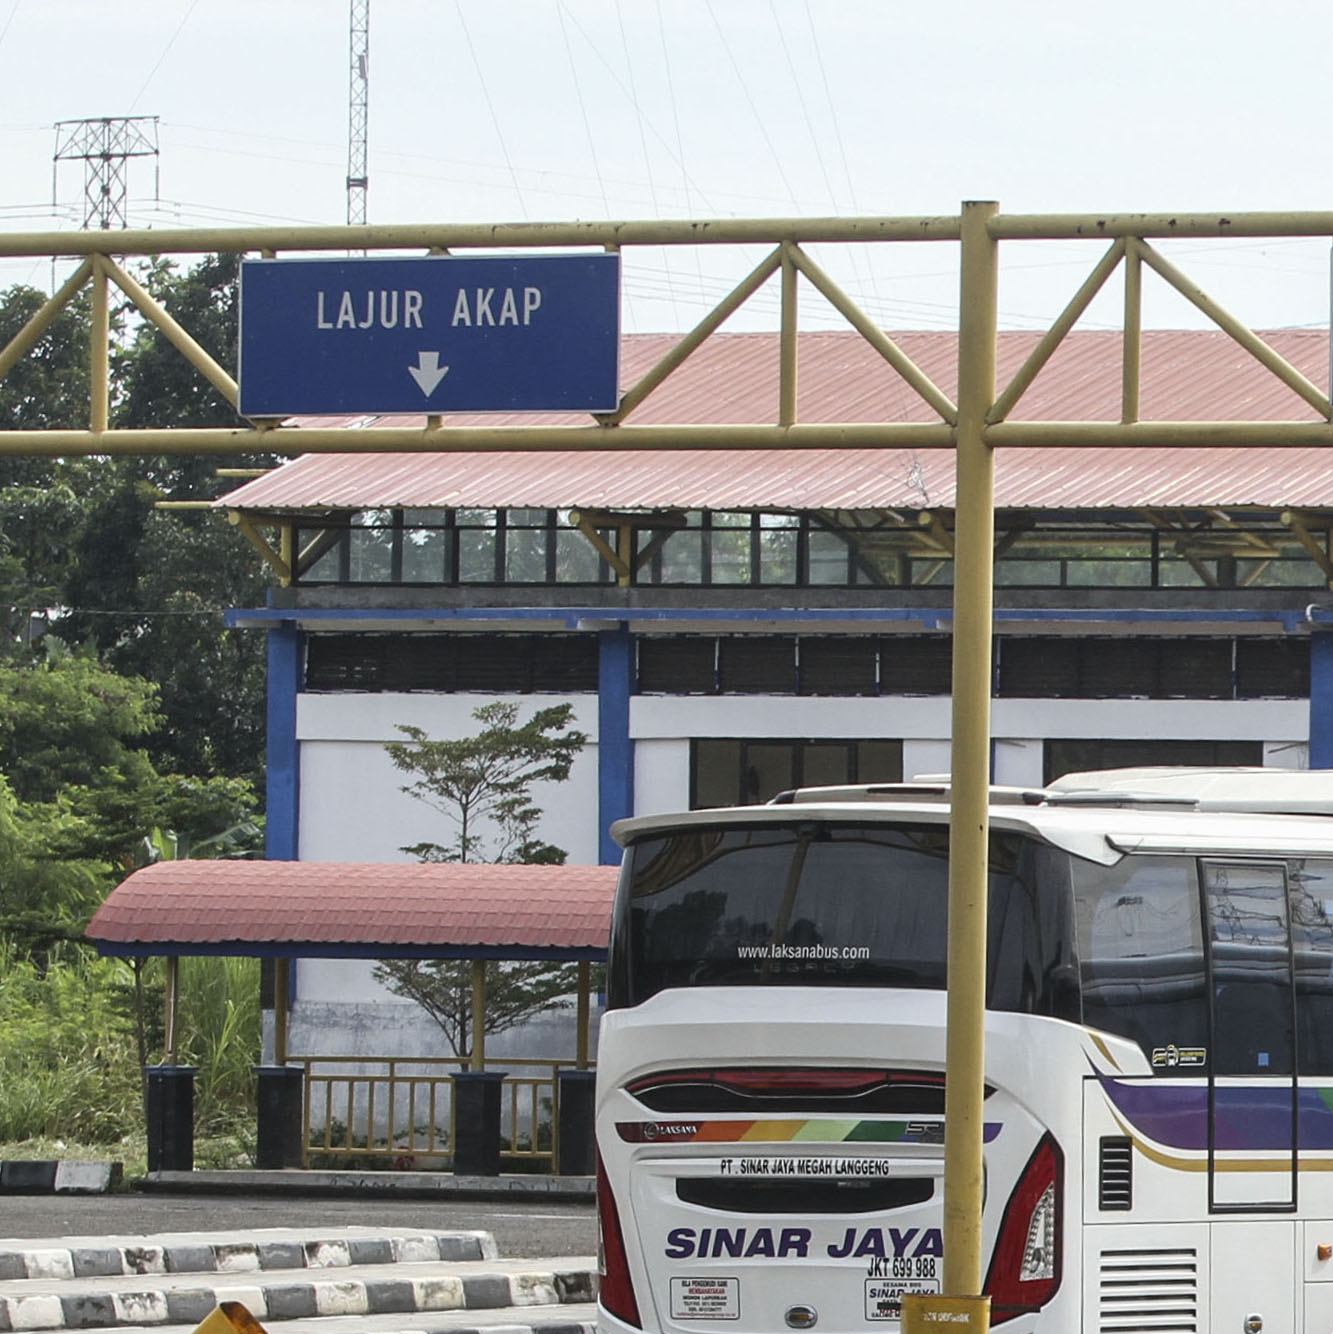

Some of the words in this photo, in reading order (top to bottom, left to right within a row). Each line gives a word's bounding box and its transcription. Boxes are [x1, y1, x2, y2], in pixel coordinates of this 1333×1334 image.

[317, 290, 423, 329] LAJUR
[451, 287, 542, 326] AKAP
[737, 943, 870, 960] www.laksanabus.com
[740, 1159, 769, 1175] SINAR
[771, 1159, 796, 1175] JAYA
[798, 1159, 832, 1176] MEGAH
[835, 1160, 889, 1176] LANGGENG
[665, 1228, 812, 1258] SINAR
[827, 1228, 943, 1258] JAYA
[867, 1257, 890, 1277] JKT
[892, 1258, 913, 1278] 699
[915, 1258, 936, 1278] 988
